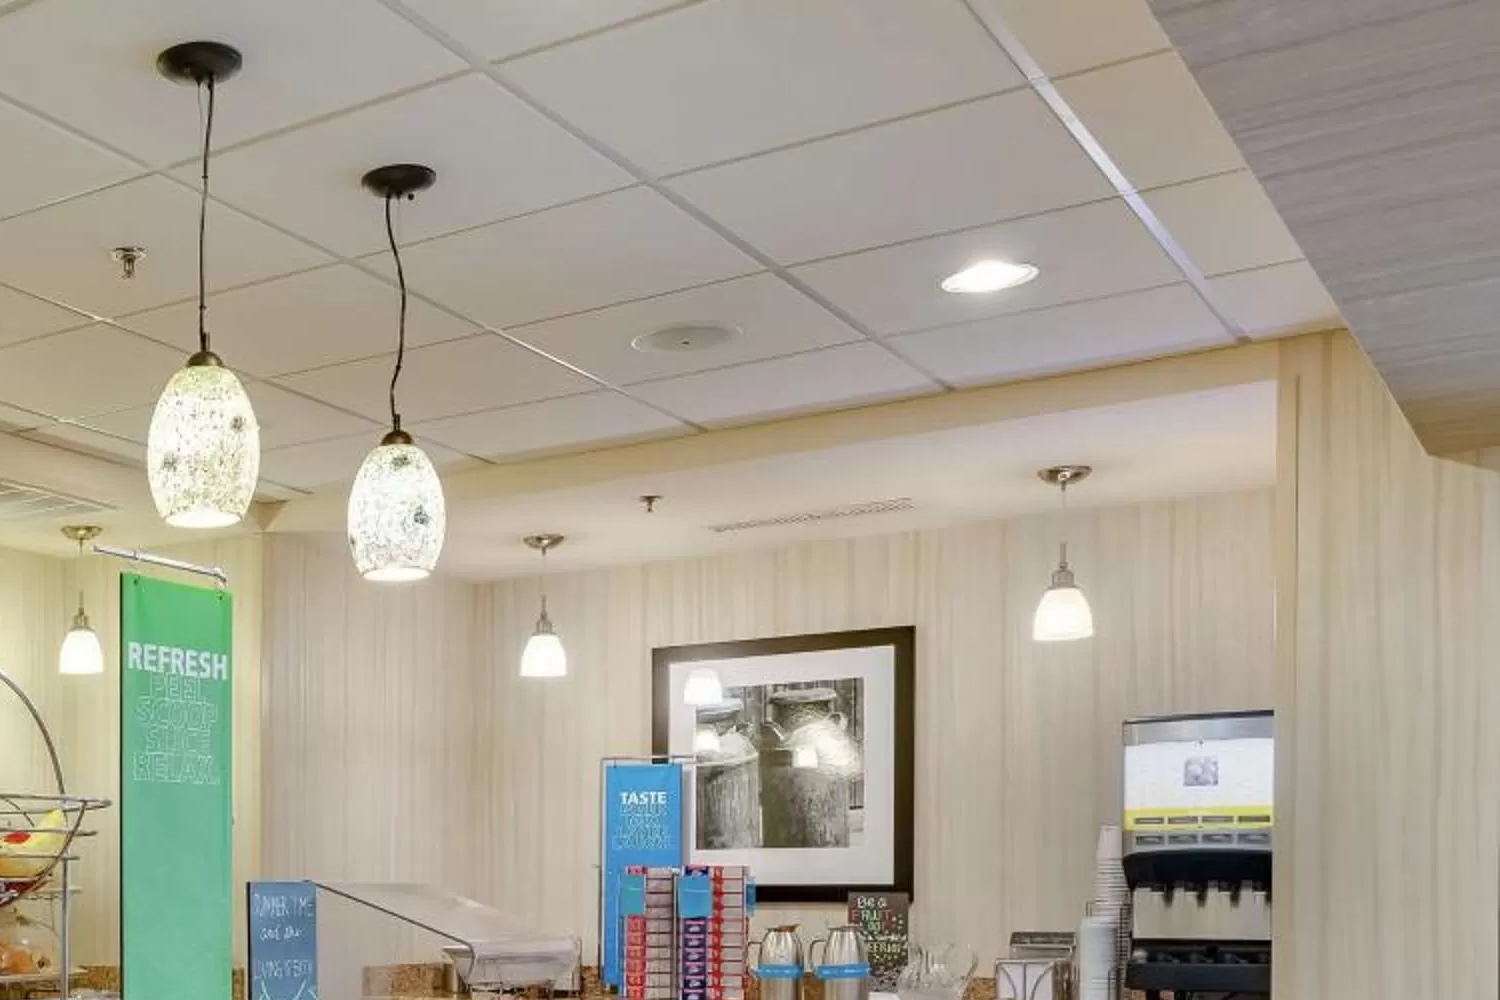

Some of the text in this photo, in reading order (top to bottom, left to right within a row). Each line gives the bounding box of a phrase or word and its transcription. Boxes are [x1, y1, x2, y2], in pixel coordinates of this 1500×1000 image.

[127, 641, 229, 681] REFRESH
[132, 752, 220, 786] RELAX
[619, 791, 668, 805] TASTE
